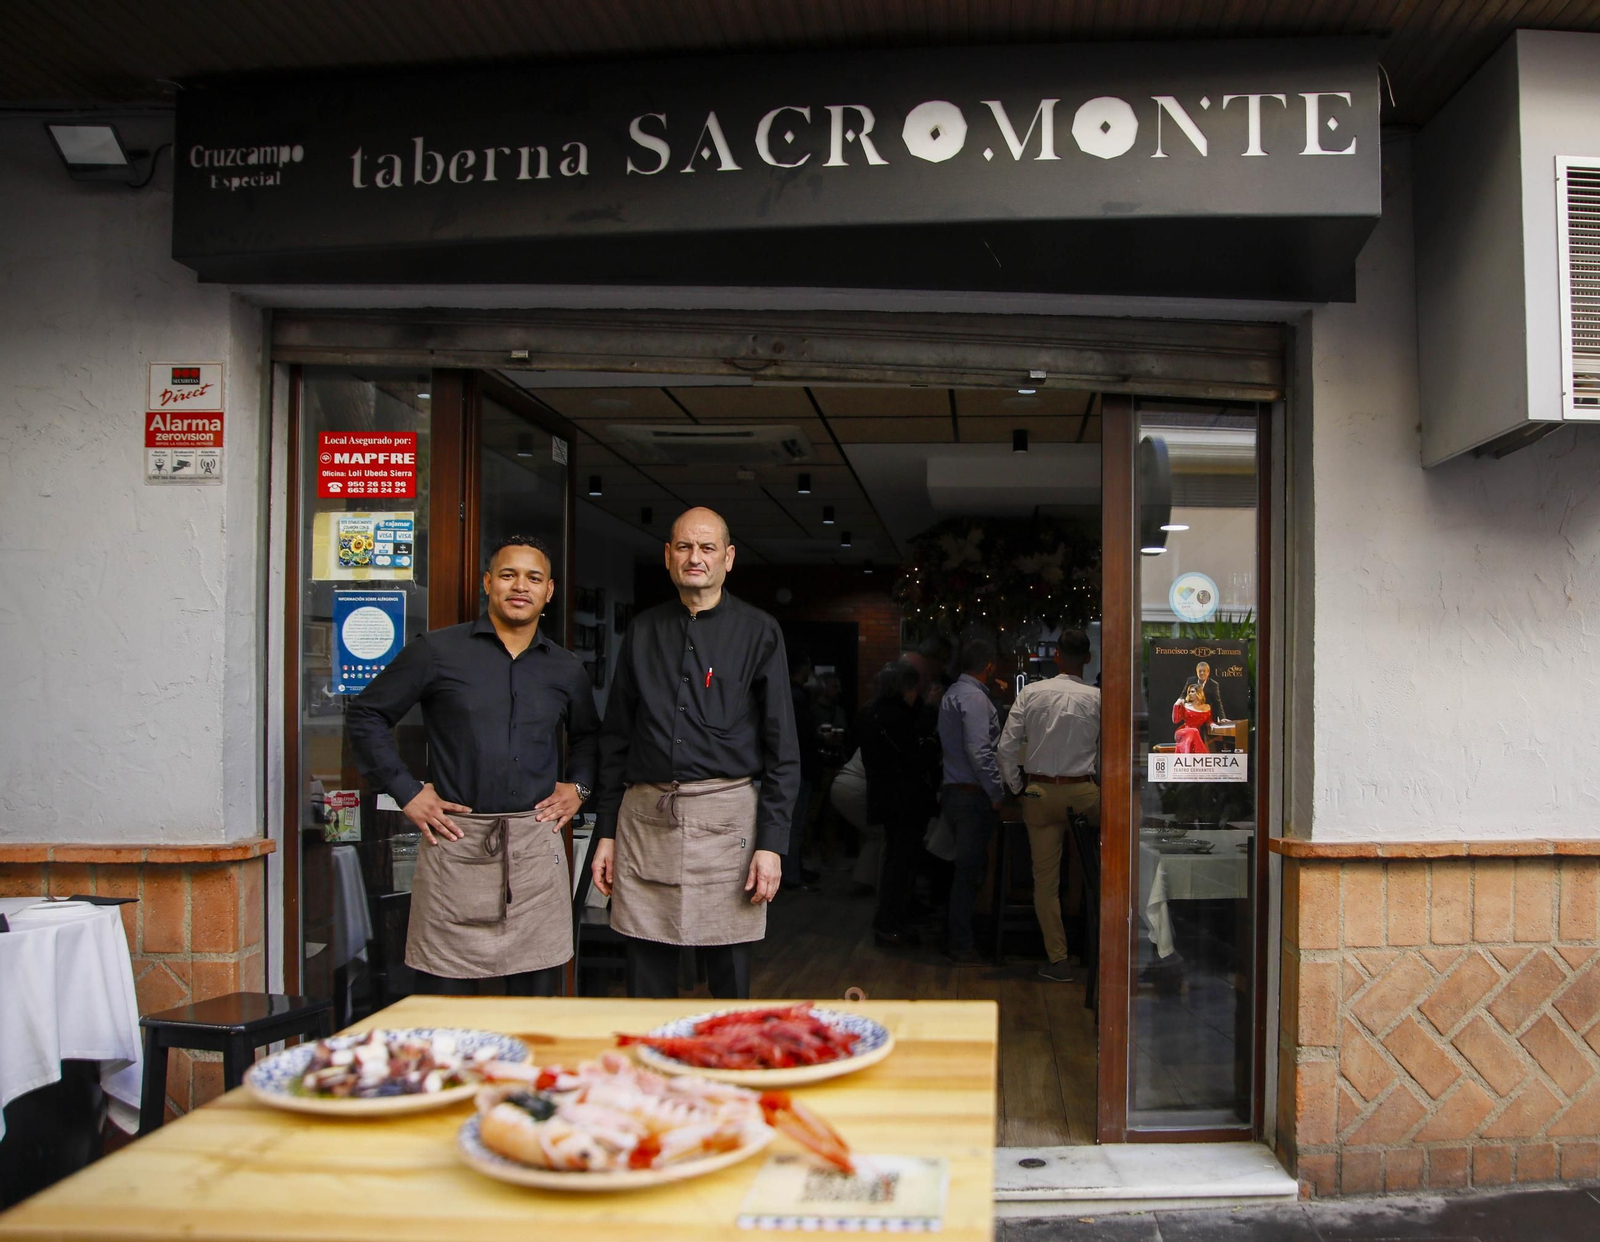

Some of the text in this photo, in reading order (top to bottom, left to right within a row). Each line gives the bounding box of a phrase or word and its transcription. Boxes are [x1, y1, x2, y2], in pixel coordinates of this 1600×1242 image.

[350, 91, 1357, 189] taberna SACROMONTE
[190, 143, 305, 168] Cruzcampo
[210, 171, 281, 191] Especial
[160, 383, 214, 406] Direct
[149, 414, 221, 431] Alarma
[155, 432, 214, 442] zerovision
[324, 435, 411, 447] Local Asegurado por:
[333, 452, 415, 465] MAPFRE
[348, 469, 362, 477] Loli
[364, 469, 388, 477] Ubeda
[390, 469, 412, 477] Sierra
[385, 520, 411, 528] cajamar
[1155, 647, 1188, 655] Francisco
[1216, 647, 1241, 655] Tamara
[1155, 762, 1166, 771] 08
[1173, 755, 1239, 767] ALMERÍA
